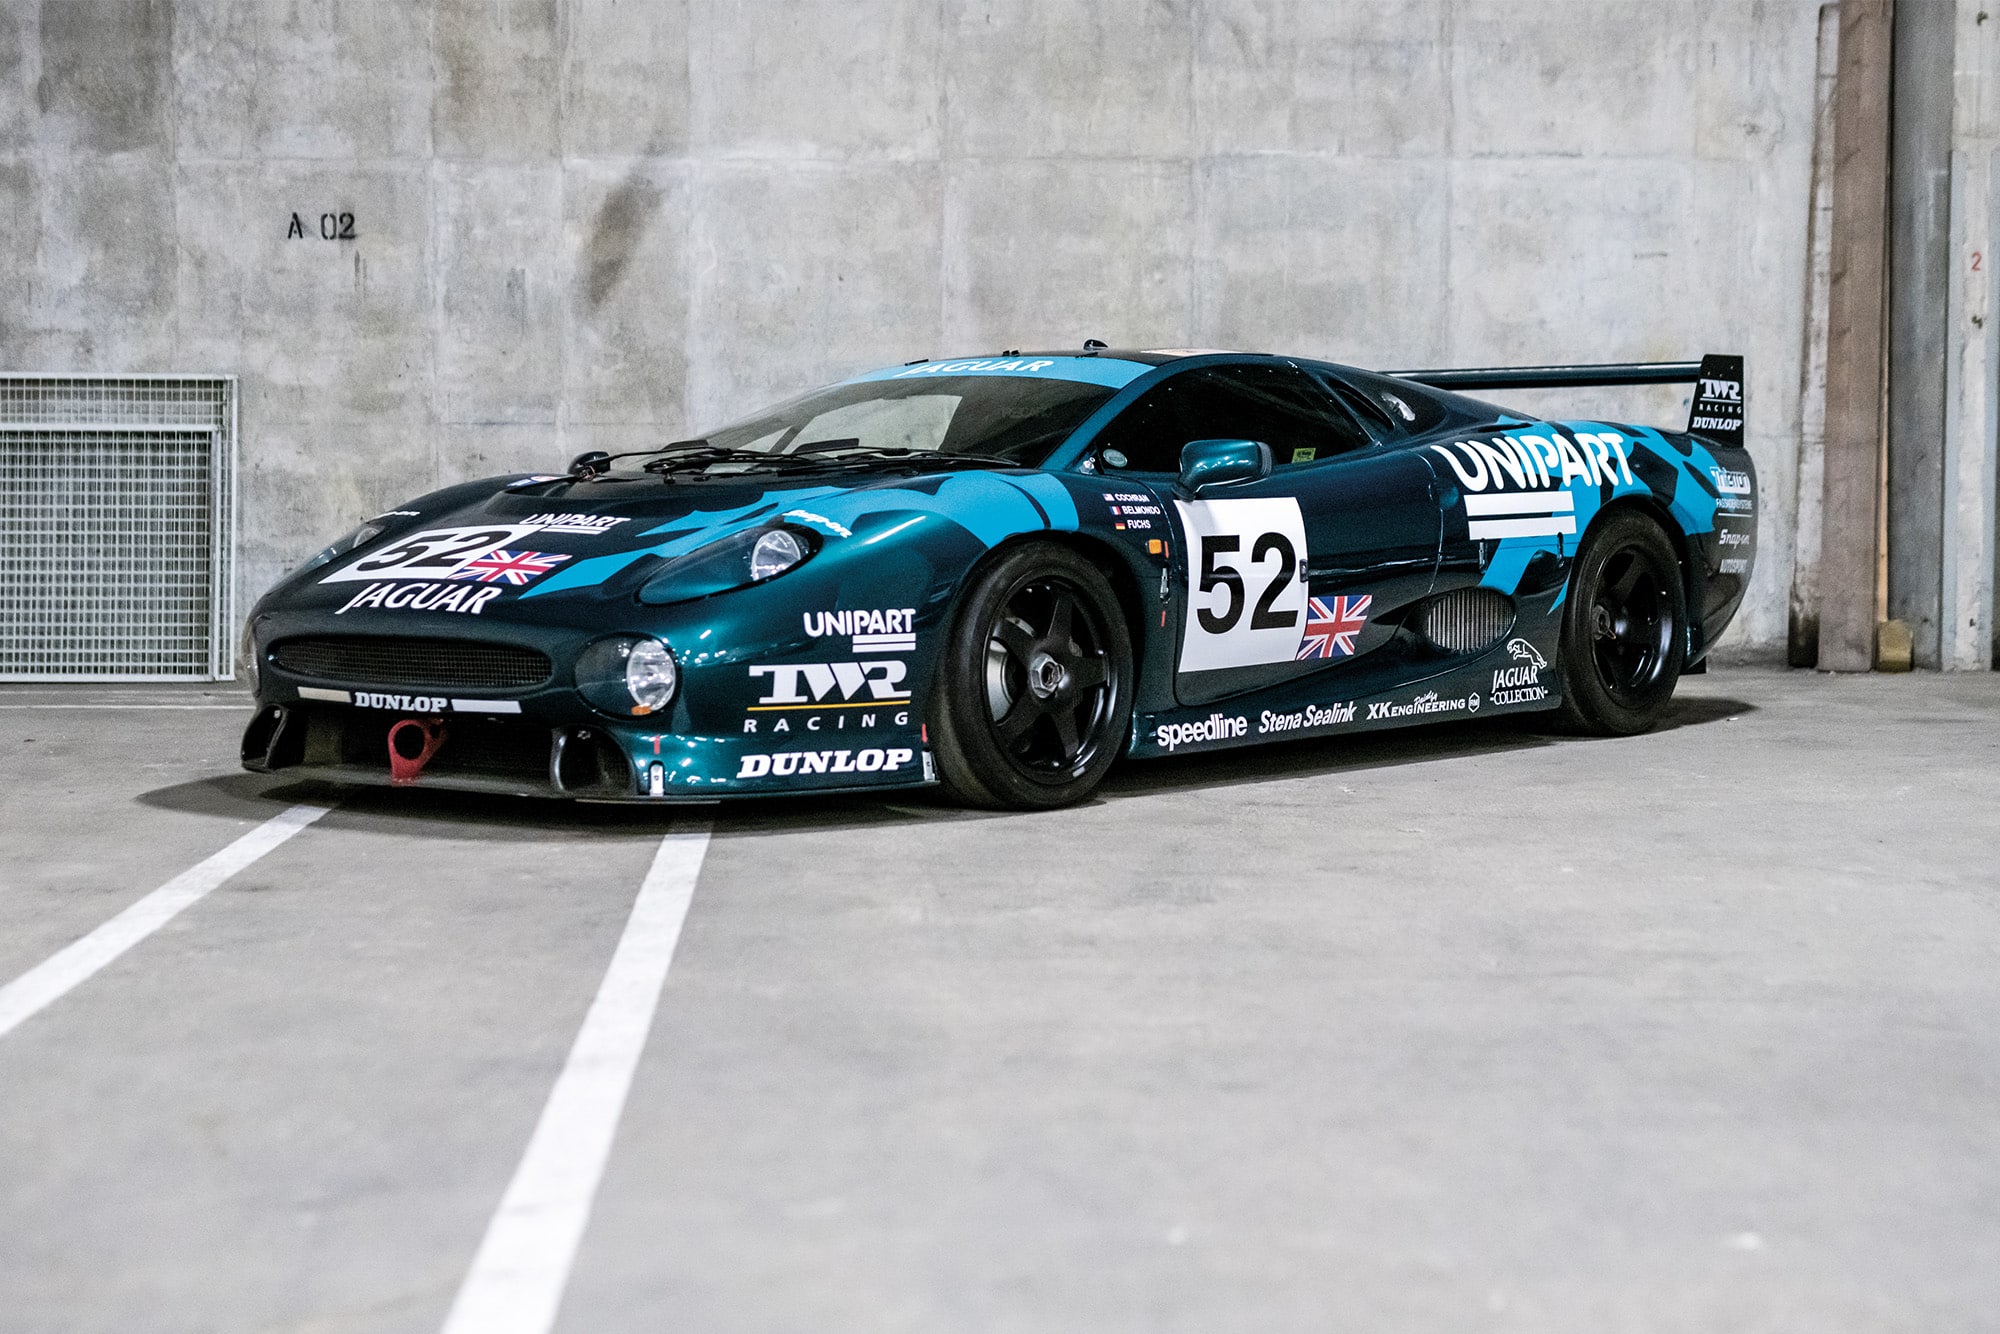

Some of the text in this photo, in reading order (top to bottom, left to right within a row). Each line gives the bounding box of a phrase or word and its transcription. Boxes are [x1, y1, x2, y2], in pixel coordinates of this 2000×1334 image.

[288, 212, 356, 240] A 02
[1971, 251, 1982, 271] 2
[893, 359, 1054, 378] JAGUAR
[1700, 379, 1741, 400] TWR
[1699, 403, 1741, 414] RACING
[1692, 416, 1742, 431] DUNLOP
[1430, 433, 1633, 492] UNIPART
[1114, 493, 1150, 502] COCHRAN
[519, 513, 631, 527] UNIPART
[1121, 505, 1161, 515] BELMONDO
[1127, 519, 1152, 529] FUCHS
[1719, 528, 1750, 549] Snap-on
[356, 531, 512, 571] 52
[1196, 532, 1299, 635] 52
[334, 582, 502, 615] JAGUAR
[803, 608, 916, 637] UNIPART
[749, 660, 911, 704] TWR
[1491, 665, 1539, 694] JAGUAR
[354, 691, 448, 713] DUNLOP
[743, 712, 909, 733] RACING
[1258, 701, 1358, 734] Stena Sealink
[1157, 713, 1248, 751] speedline
[736, 748, 913, 779] DUNLOP
